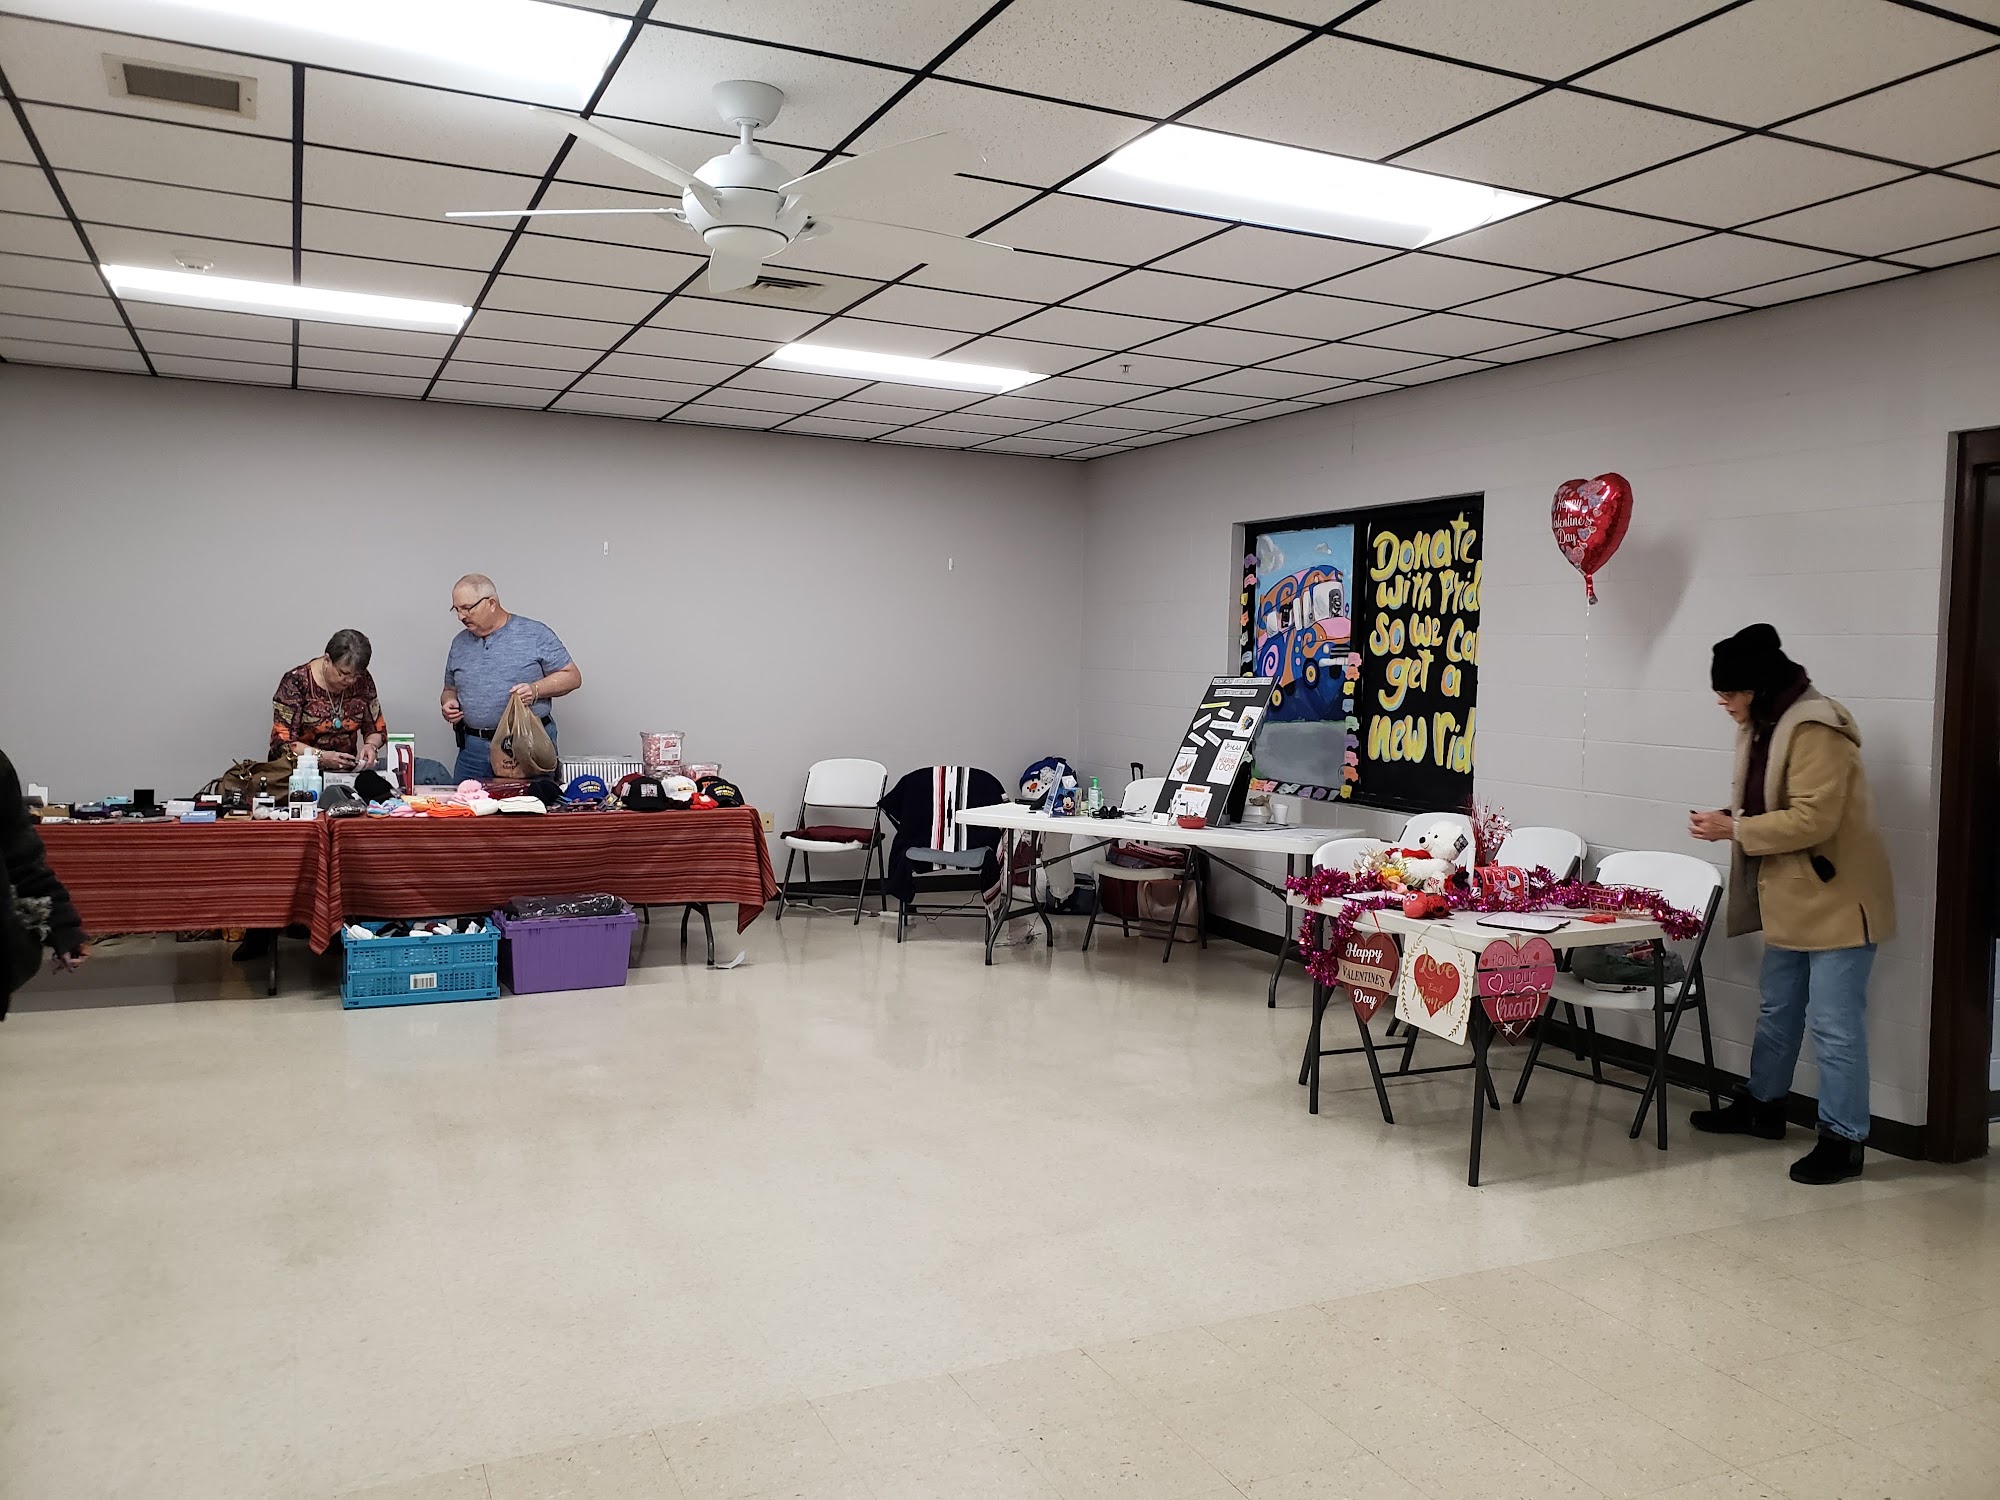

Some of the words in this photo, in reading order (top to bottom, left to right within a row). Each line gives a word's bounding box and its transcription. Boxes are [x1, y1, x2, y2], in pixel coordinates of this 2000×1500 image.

[1556, 495, 1583, 512] Happy
[1370, 511, 1477, 581] Donate
[1557, 528, 1577, 546] Day
[1376, 571, 1433, 611] with
[1439, 560, 1481, 616] Prid
[1370, 612, 1405, 656] So
[1378, 649, 1434, 712] get
[1441, 664, 1461, 697] a
[1367, 713, 1427, 763] new
[1432, 706, 1476, 774] rid
[1215, 763, 1235, 772] LOOP
[1345, 942, 1383, 964] Happy
[1418, 945, 1456, 980] Love
[1493, 953, 1530, 967] follow
[1342, 965, 1385, 988] VALENTINE'S
[1507, 971, 1537, 993] your
[1353, 988, 1378, 1010] Day
[1499, 996, 1535, 1019] heart
